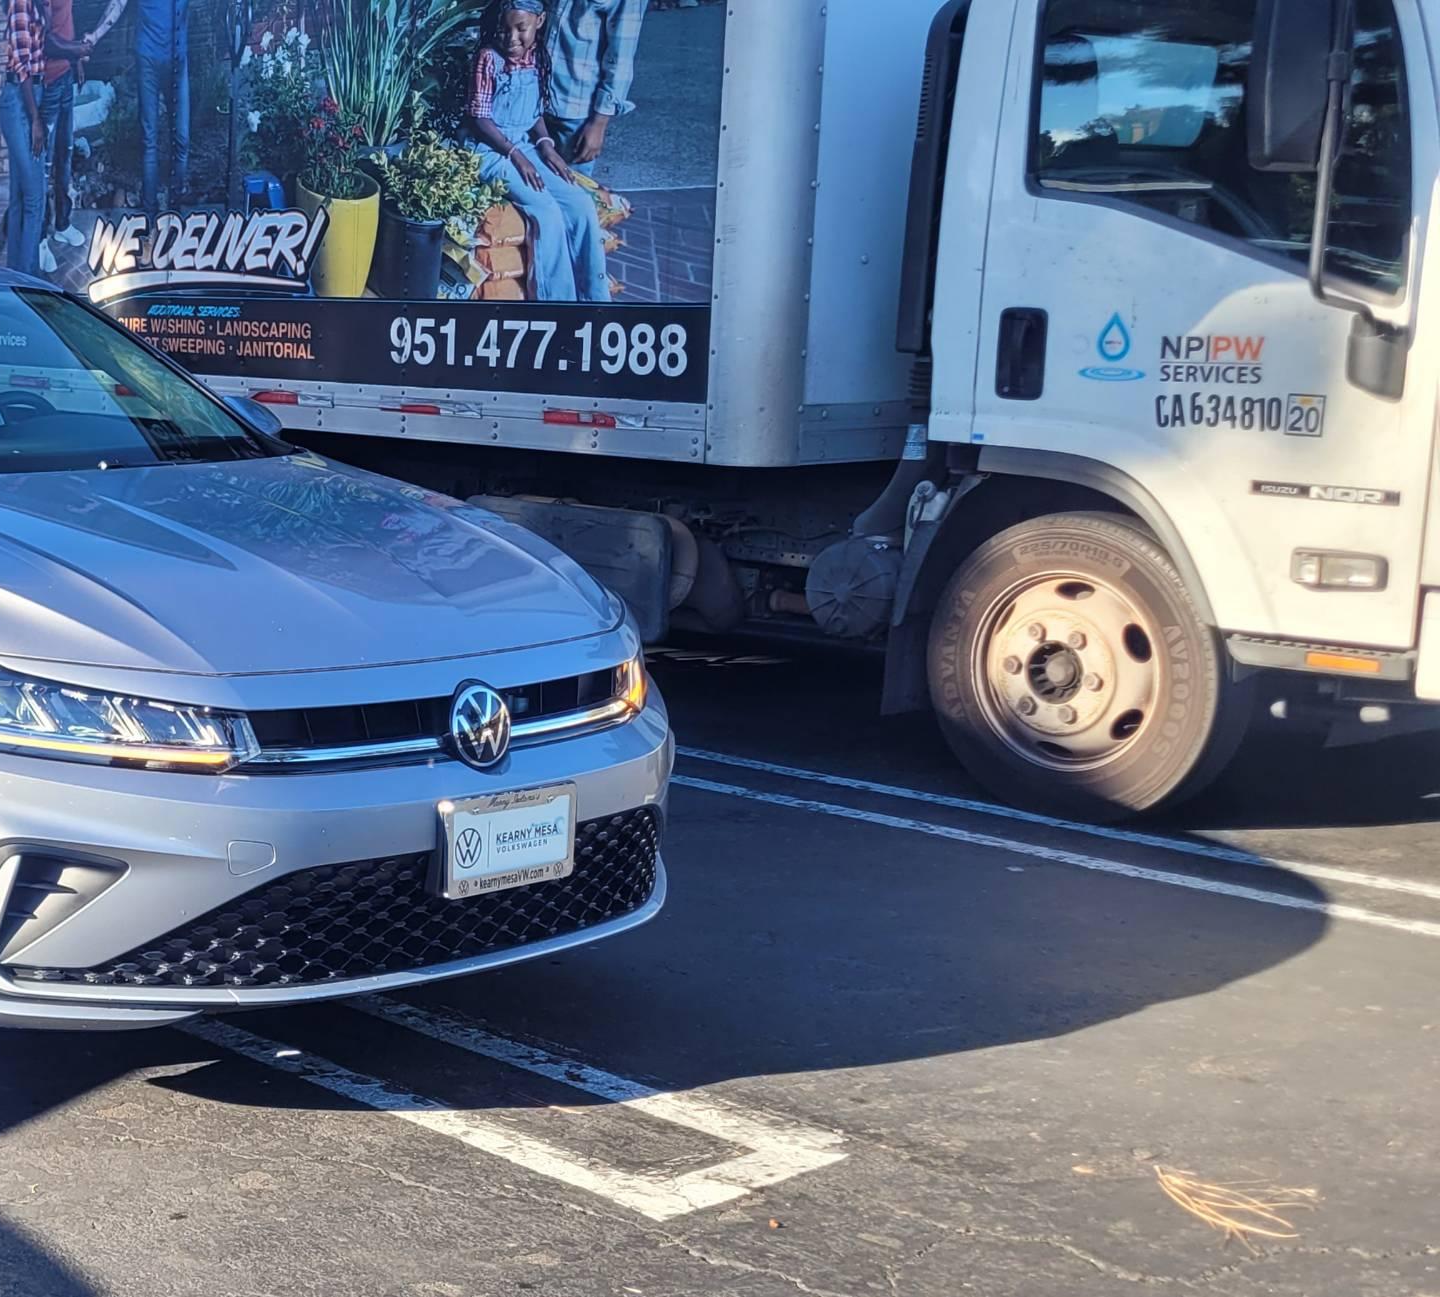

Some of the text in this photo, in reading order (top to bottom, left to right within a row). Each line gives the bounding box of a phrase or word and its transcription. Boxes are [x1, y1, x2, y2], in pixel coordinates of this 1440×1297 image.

[88, 206, 327, 276] WE DELIVER!
[147, 305, 195, 317] ADDITIONAL
[150, 319, 206, 335] WASHING
[216, 320, 312, 339] LANDSCAPING
[161, 338, 226, 355] SWEEPING
[236, 341, 316, 360] JANITORIAL
[390, 316, 689, 378] 951.477.1988
[1160, 365, 1262, 385] SERVICES
[1288, 405, 1320, 433] 20
[1261, 484, 1386, 504] ISUZU NQR
[496, 823, 559, 844] KEARNY MESA
[496, 838, 549, 854] VOLKSWAGEN
[479, 867, 545, 890] kearnymesaVW.com
